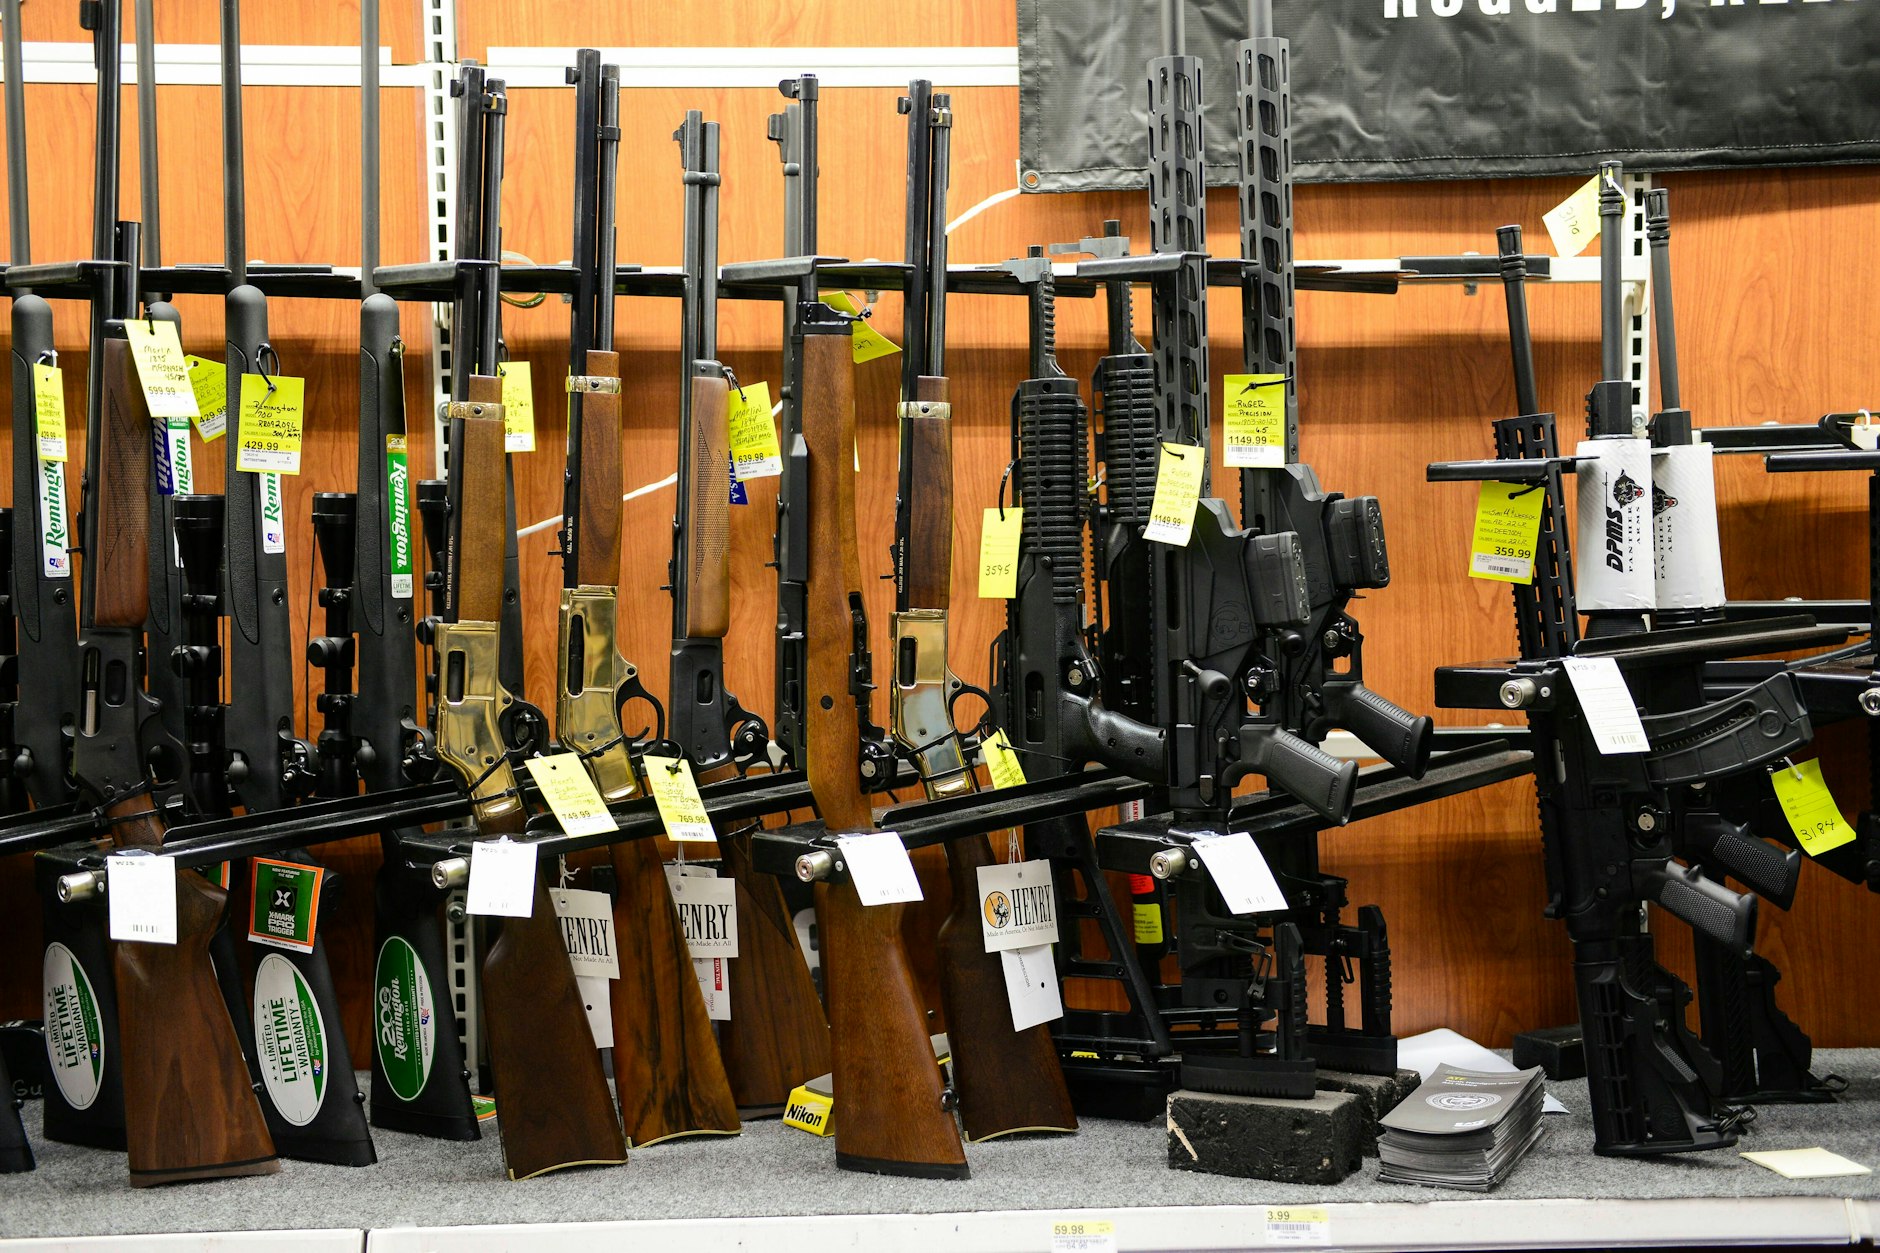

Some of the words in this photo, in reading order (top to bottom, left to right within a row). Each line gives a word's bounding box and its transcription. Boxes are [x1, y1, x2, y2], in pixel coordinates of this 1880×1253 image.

[149, 386, 176, 396] 599.99
[245, 441, 279, 450] 429.99
[1229, 436, 1267, 444] 1149.99
[739, 452, 764, 463] 639.98
[389, 459, 409, 569] Remington
[1154, 514, 1182, 527] 1149.99
[1605, 506, 1624, 573] DPMS
[1494, 546, 1531, 559] 359.99
[1658, 516, 1666, 580] PANTHER
[986, 563, 1011, 577] 3595
[562, 810, 591, 820] 749.99
[678, 815, 706, 824] 769.98
[1800, 819, 1835, 841] 3184
[1011, 884, 1052, 927] HENRY
[269, 911, 295, 922] X-MARK
[268, 919, 295, 929] PRO
[268, 925, 295, 936] TRIGGER
[53, 984, 79, 1068] LIFETIME
[69, 994, 88, 1053] WARRANTY
[390, 978, 409, 1062] Remington
[49, 1011, 61, 1049] LIMITED
[305, 1025, 313, 1039] Made
[264, 1024, 277, 1063] LIMITED
[270, 997, 298, 1083] LIFETIME
[289, 1008, 309, 1069] WARRANTY
[787, 1103, 822, 1127] Nikon
[1267, 1211, 1290, 1220] 3.99
[1055, 1225, 1084, 1235] 59.98
